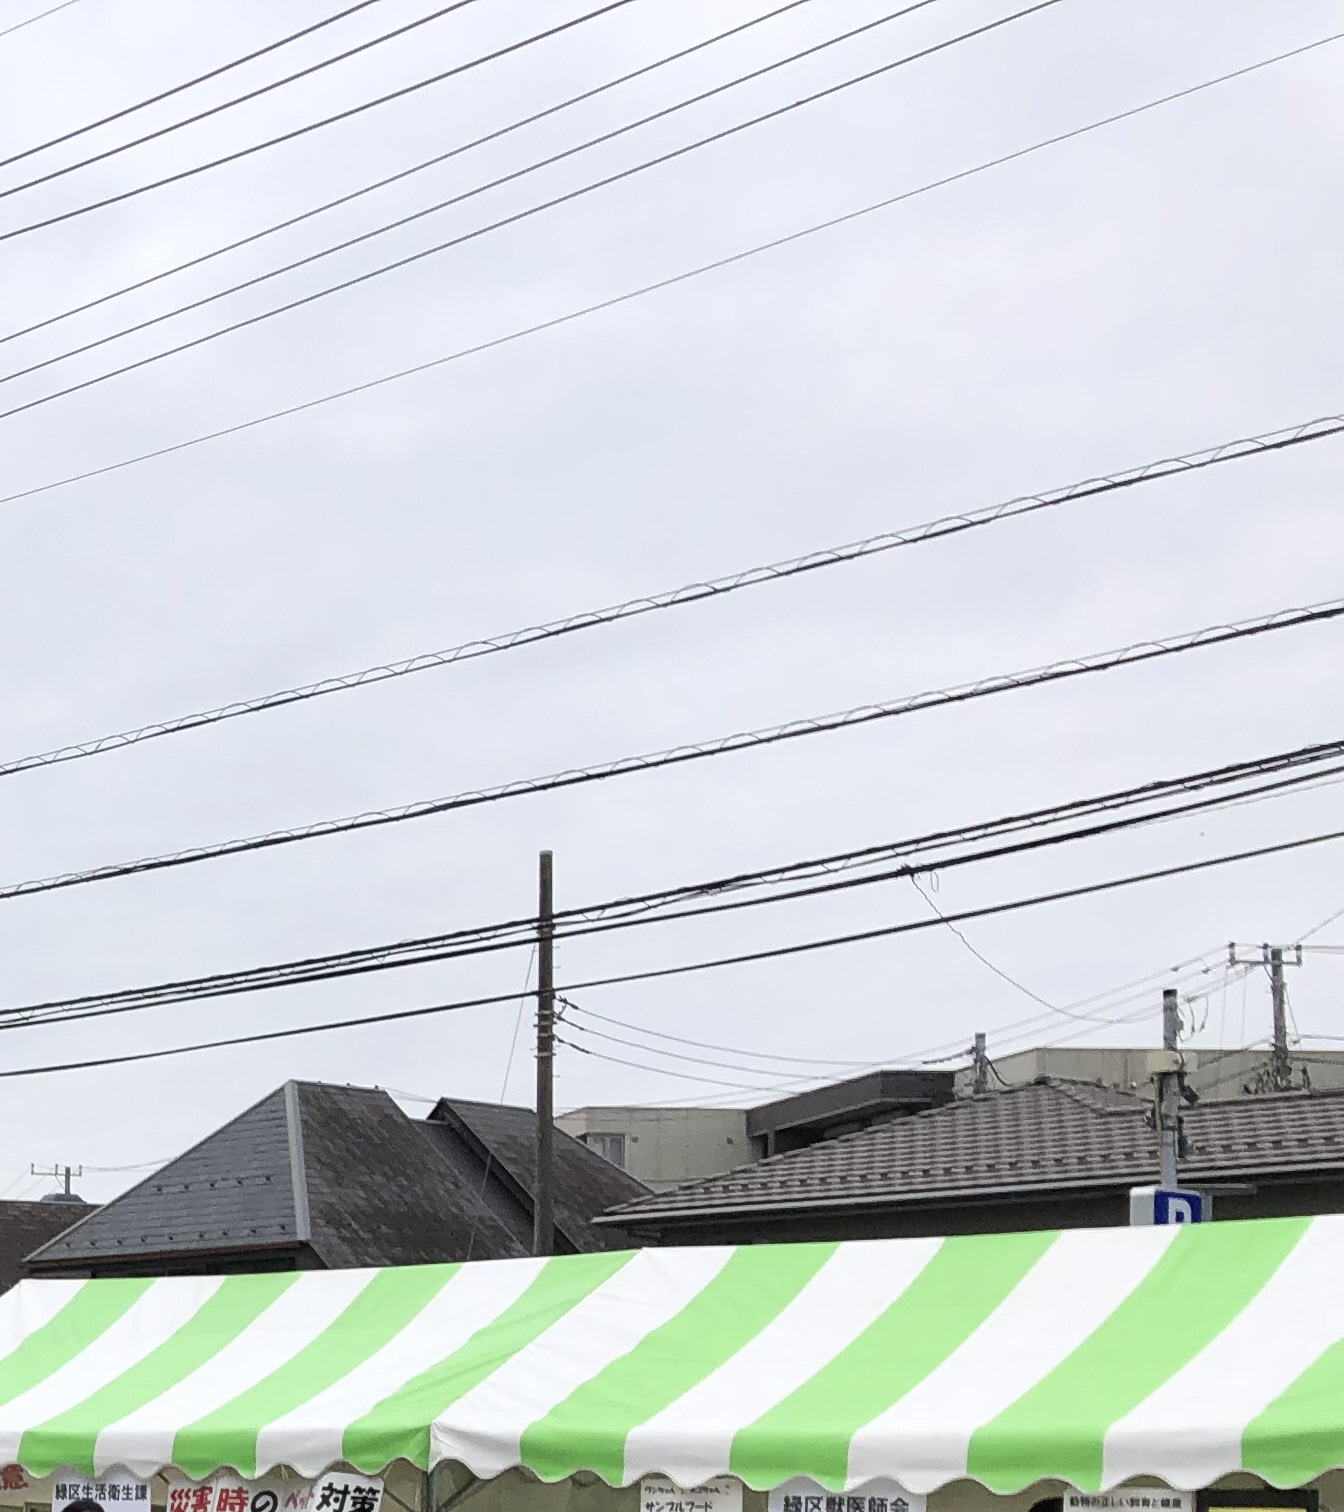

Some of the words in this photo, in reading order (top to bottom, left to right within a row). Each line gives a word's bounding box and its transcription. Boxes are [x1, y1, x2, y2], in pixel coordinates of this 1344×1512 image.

[55, 1483, 148, 1501] 緑区生活衛生課
